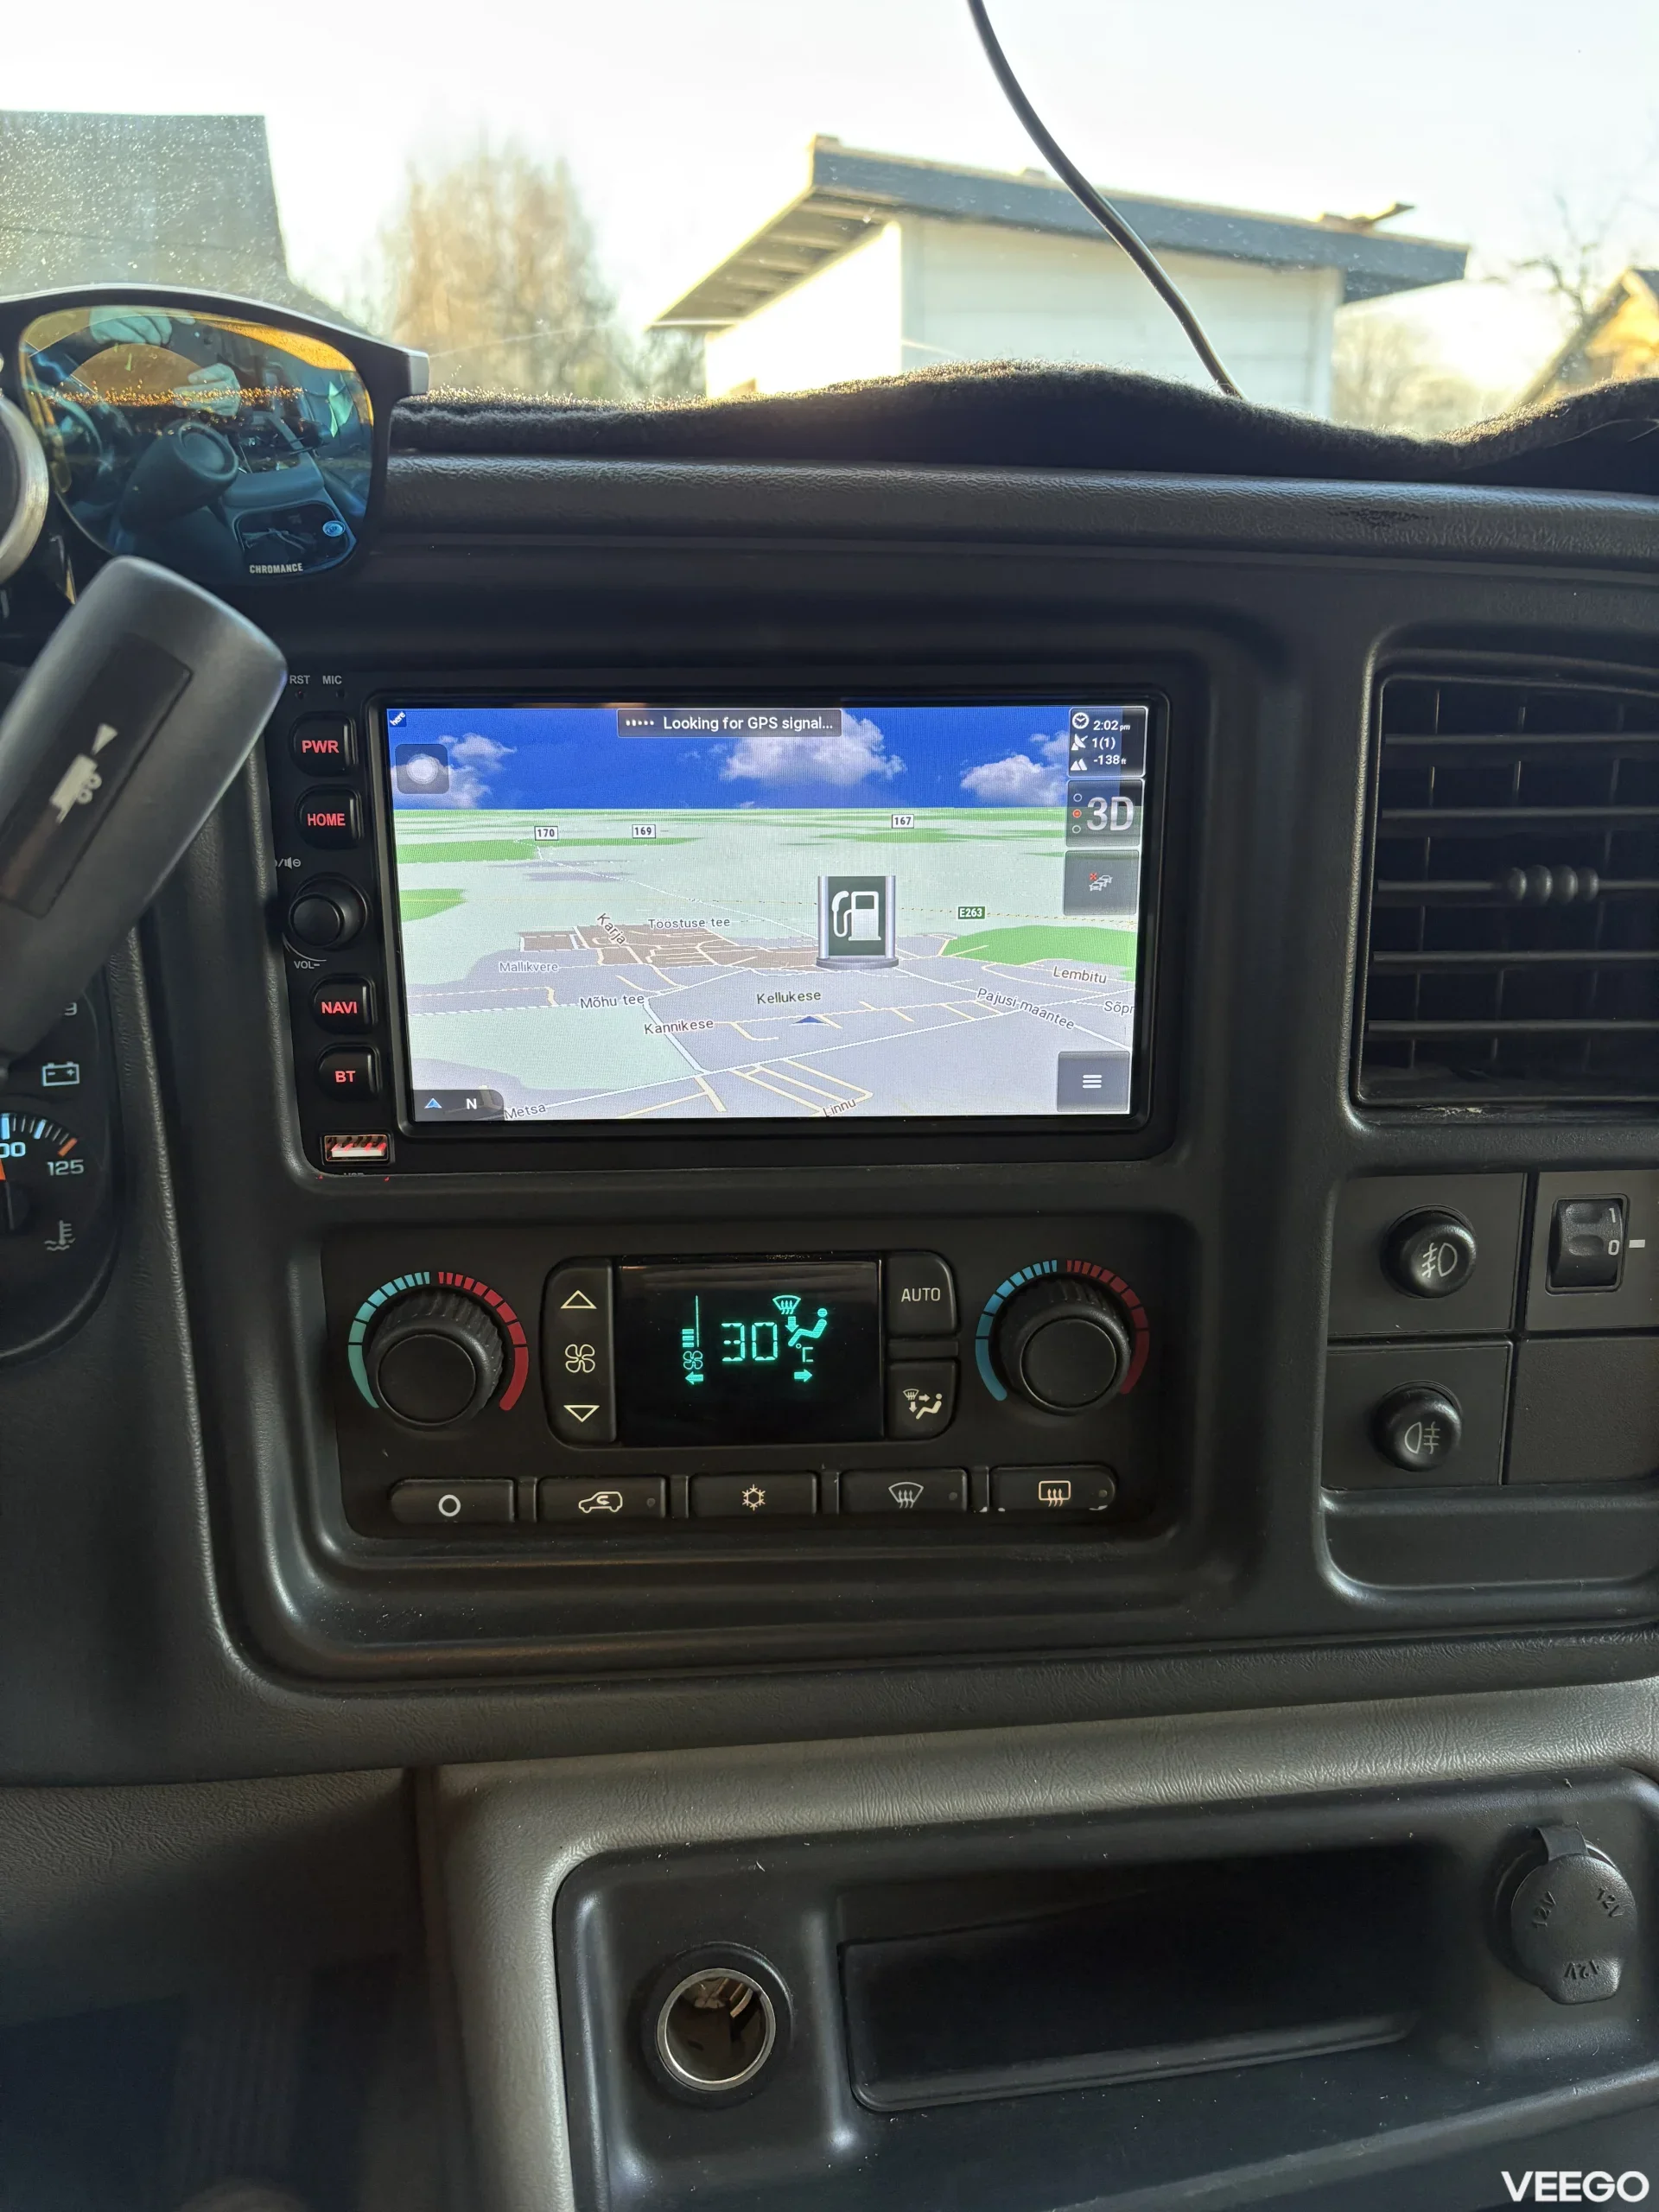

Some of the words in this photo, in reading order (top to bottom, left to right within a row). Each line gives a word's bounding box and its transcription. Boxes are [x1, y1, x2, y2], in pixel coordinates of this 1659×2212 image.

[249, 563, 303, 574] CHROMANCE
[289, 675, 310, 684] RST
[322, 675, 342, 684] MIC
[389, 711, 406, 726] here
[664, 715, 719, 732] Looking
[723, 715, 744, 730] for
[747, 716, 778, 729] GPS
[781, 715, 833, 732] signal...
[1093, 720, 1119, 731] 2:02
[1120, 723, 1131, 732] pm
[302, 740, 340, 753] PWR
[1091, 736, 1116, 751] 1(1)
[1093, 754, 1120, 766] -138
[307, 813, 346, 827] HOME
[1086, 796, 1135, 831] 3D
[894, 817, 912, 826] 167
[537, 829, 556, 837] 170
[635, 827, 652, 836] 169
[959, 907, 982, 918] E263
[596, 912, 627, 945] Karja
[648, 918, 706, 929] Tööstuse
[710, 918, 730, 927] tee
[1053, 966, 1107, 984] Lembitu
[580, 995, 617, 1009] Mõhu
[623, 995, 645, 1006] tee
[757, 991, 822, 1005] Kellukese
[321, 1001, 358, 1014] NAVI
[976, 988, 1017, 1007] Pajusi
[1020, 1001, 1075, 1030] maantee
[335, 1071, 356, 1083] BT
[466, 1099, 478, 1109] N
[504, 1104, 546, 1120] Metsa
[47, 1160, 85, 1176] 125
[1608, 1239, 1620, 1255] 0
[901, 1287, 941, 1302] AUTO
[721, 1322, 778, 1362] 30
